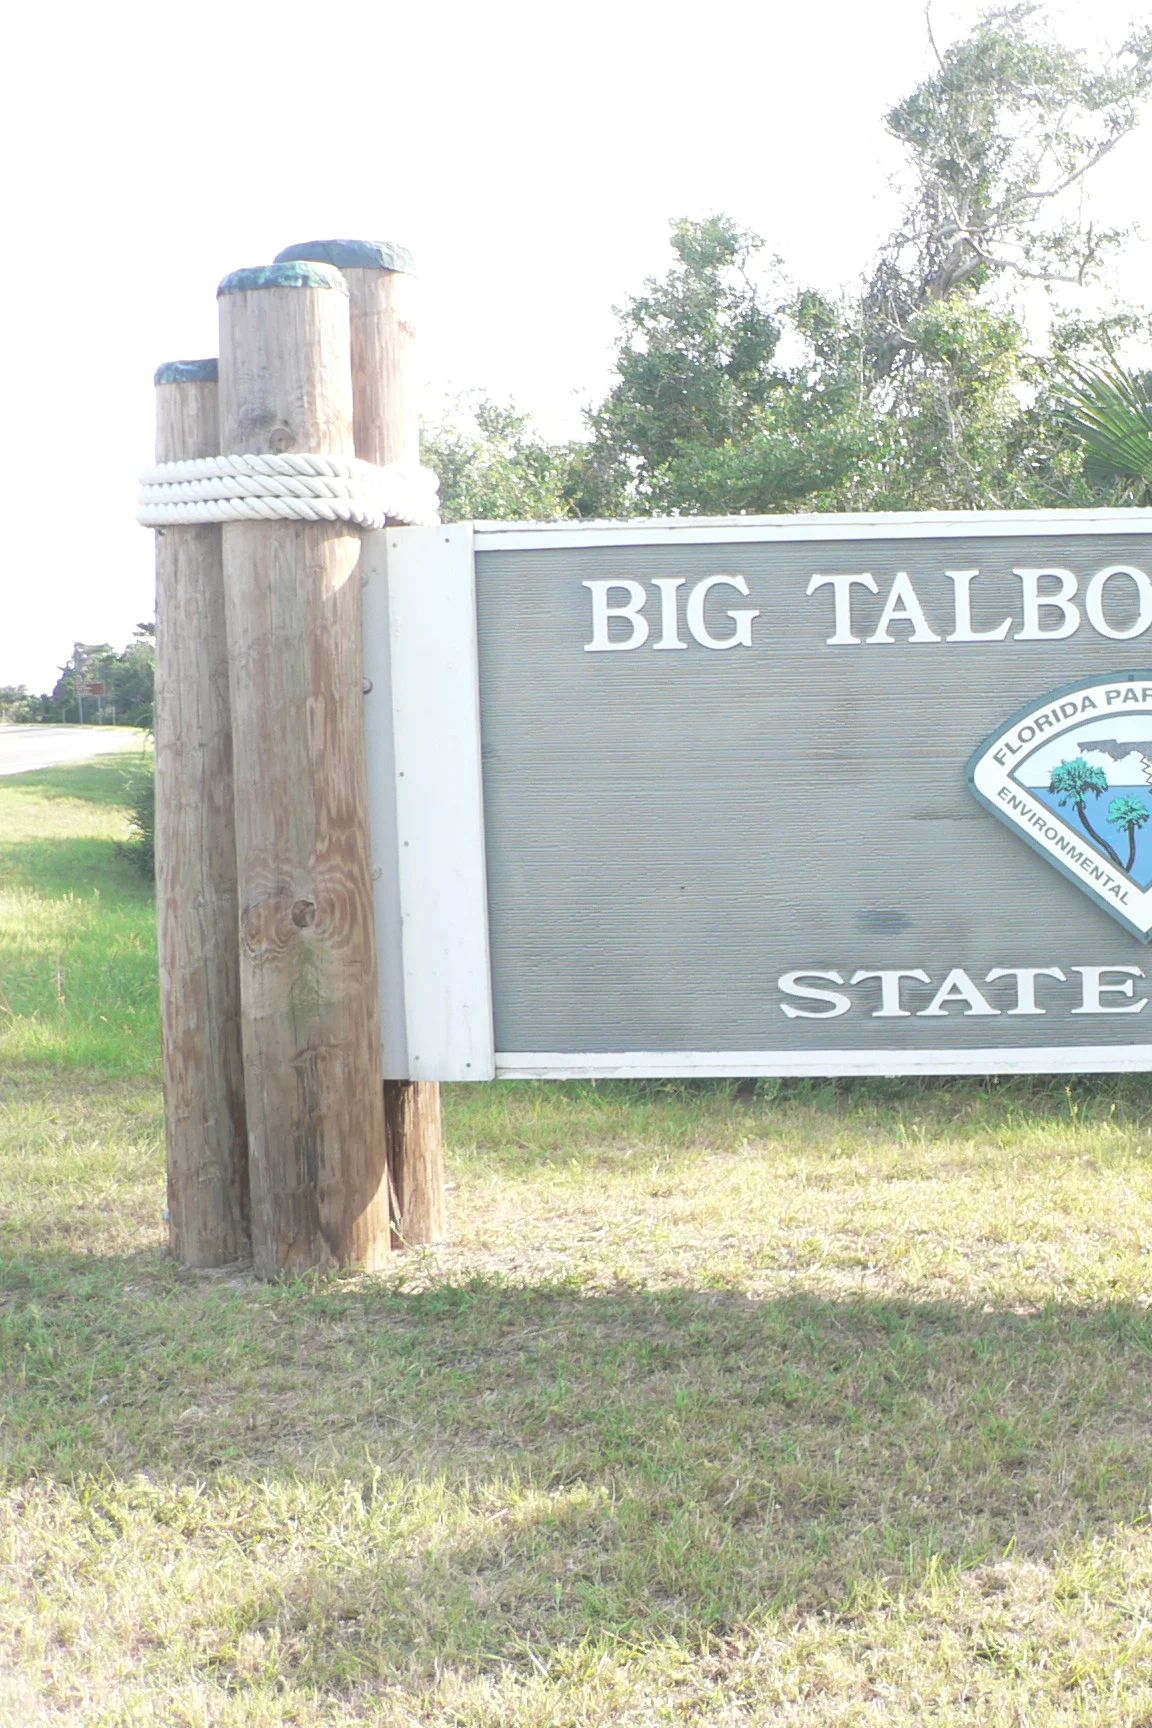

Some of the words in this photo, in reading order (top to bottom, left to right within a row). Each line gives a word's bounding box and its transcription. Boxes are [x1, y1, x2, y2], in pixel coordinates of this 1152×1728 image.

[582, 575, 760, 652] BIG
[992, 695, 1098, 767] FLORIDA
[996, 786, 1131, 907] ENVIRONMENTAL
[777, 966, 1148, 1019] STATE
